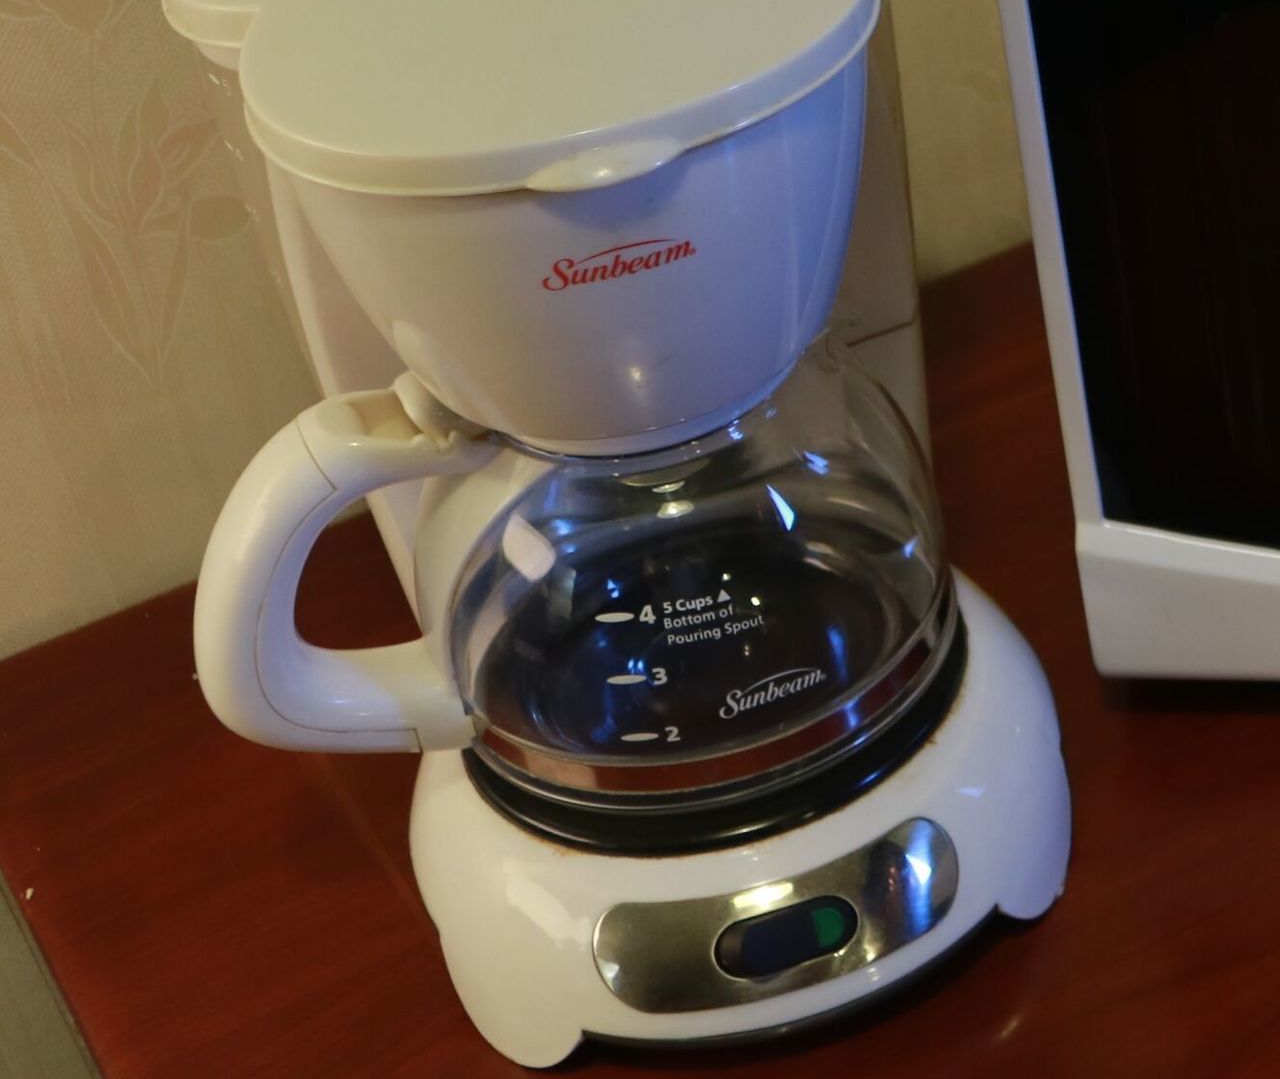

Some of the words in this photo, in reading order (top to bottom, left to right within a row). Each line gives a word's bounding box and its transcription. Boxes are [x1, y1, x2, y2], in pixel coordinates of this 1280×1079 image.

[542, 240, 693, 291] Sunbeam
[638, 604, 657, 624] 4
[663, 601, 672, 614] 5
[676, 595, 713, 612] Cups
[663, 611, 716, 630] Bottom
[719, 604, 734, 618] of
[667, 624, 721, 646] Pouring
[725, 614, 765, 636] Spout
[651, 667, 668, 686] 3
[718, 668, 824, 720] Sunbeam
[664, 725, 681, 743] 2
